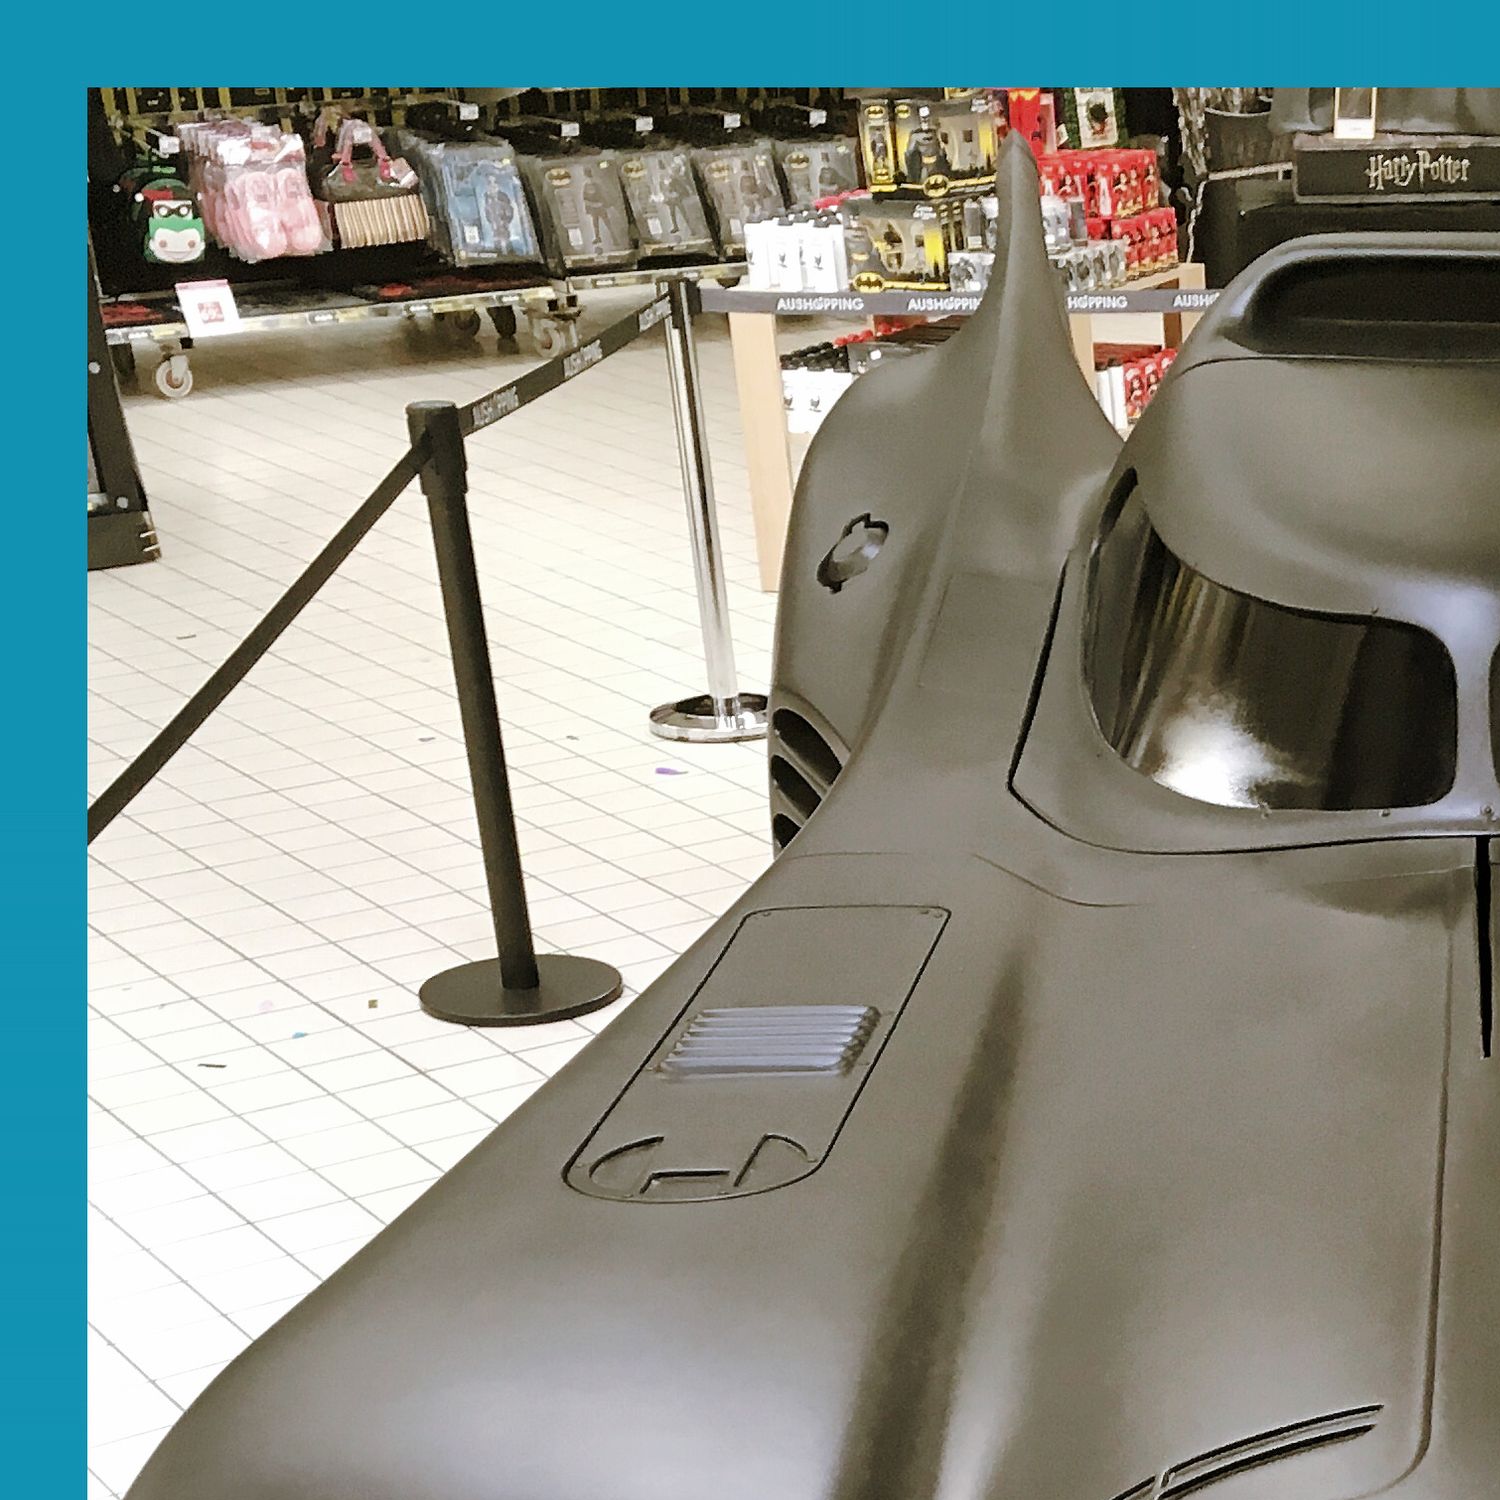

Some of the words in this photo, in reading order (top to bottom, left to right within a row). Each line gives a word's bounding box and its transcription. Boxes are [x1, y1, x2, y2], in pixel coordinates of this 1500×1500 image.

[1363, 154, 1417, 191] Harry
[1416, 149, 1471, 189] Potter
[776, 296, 864, 312] AUSHOPPING
[1066, 294, 1129, 309] HOPPING
